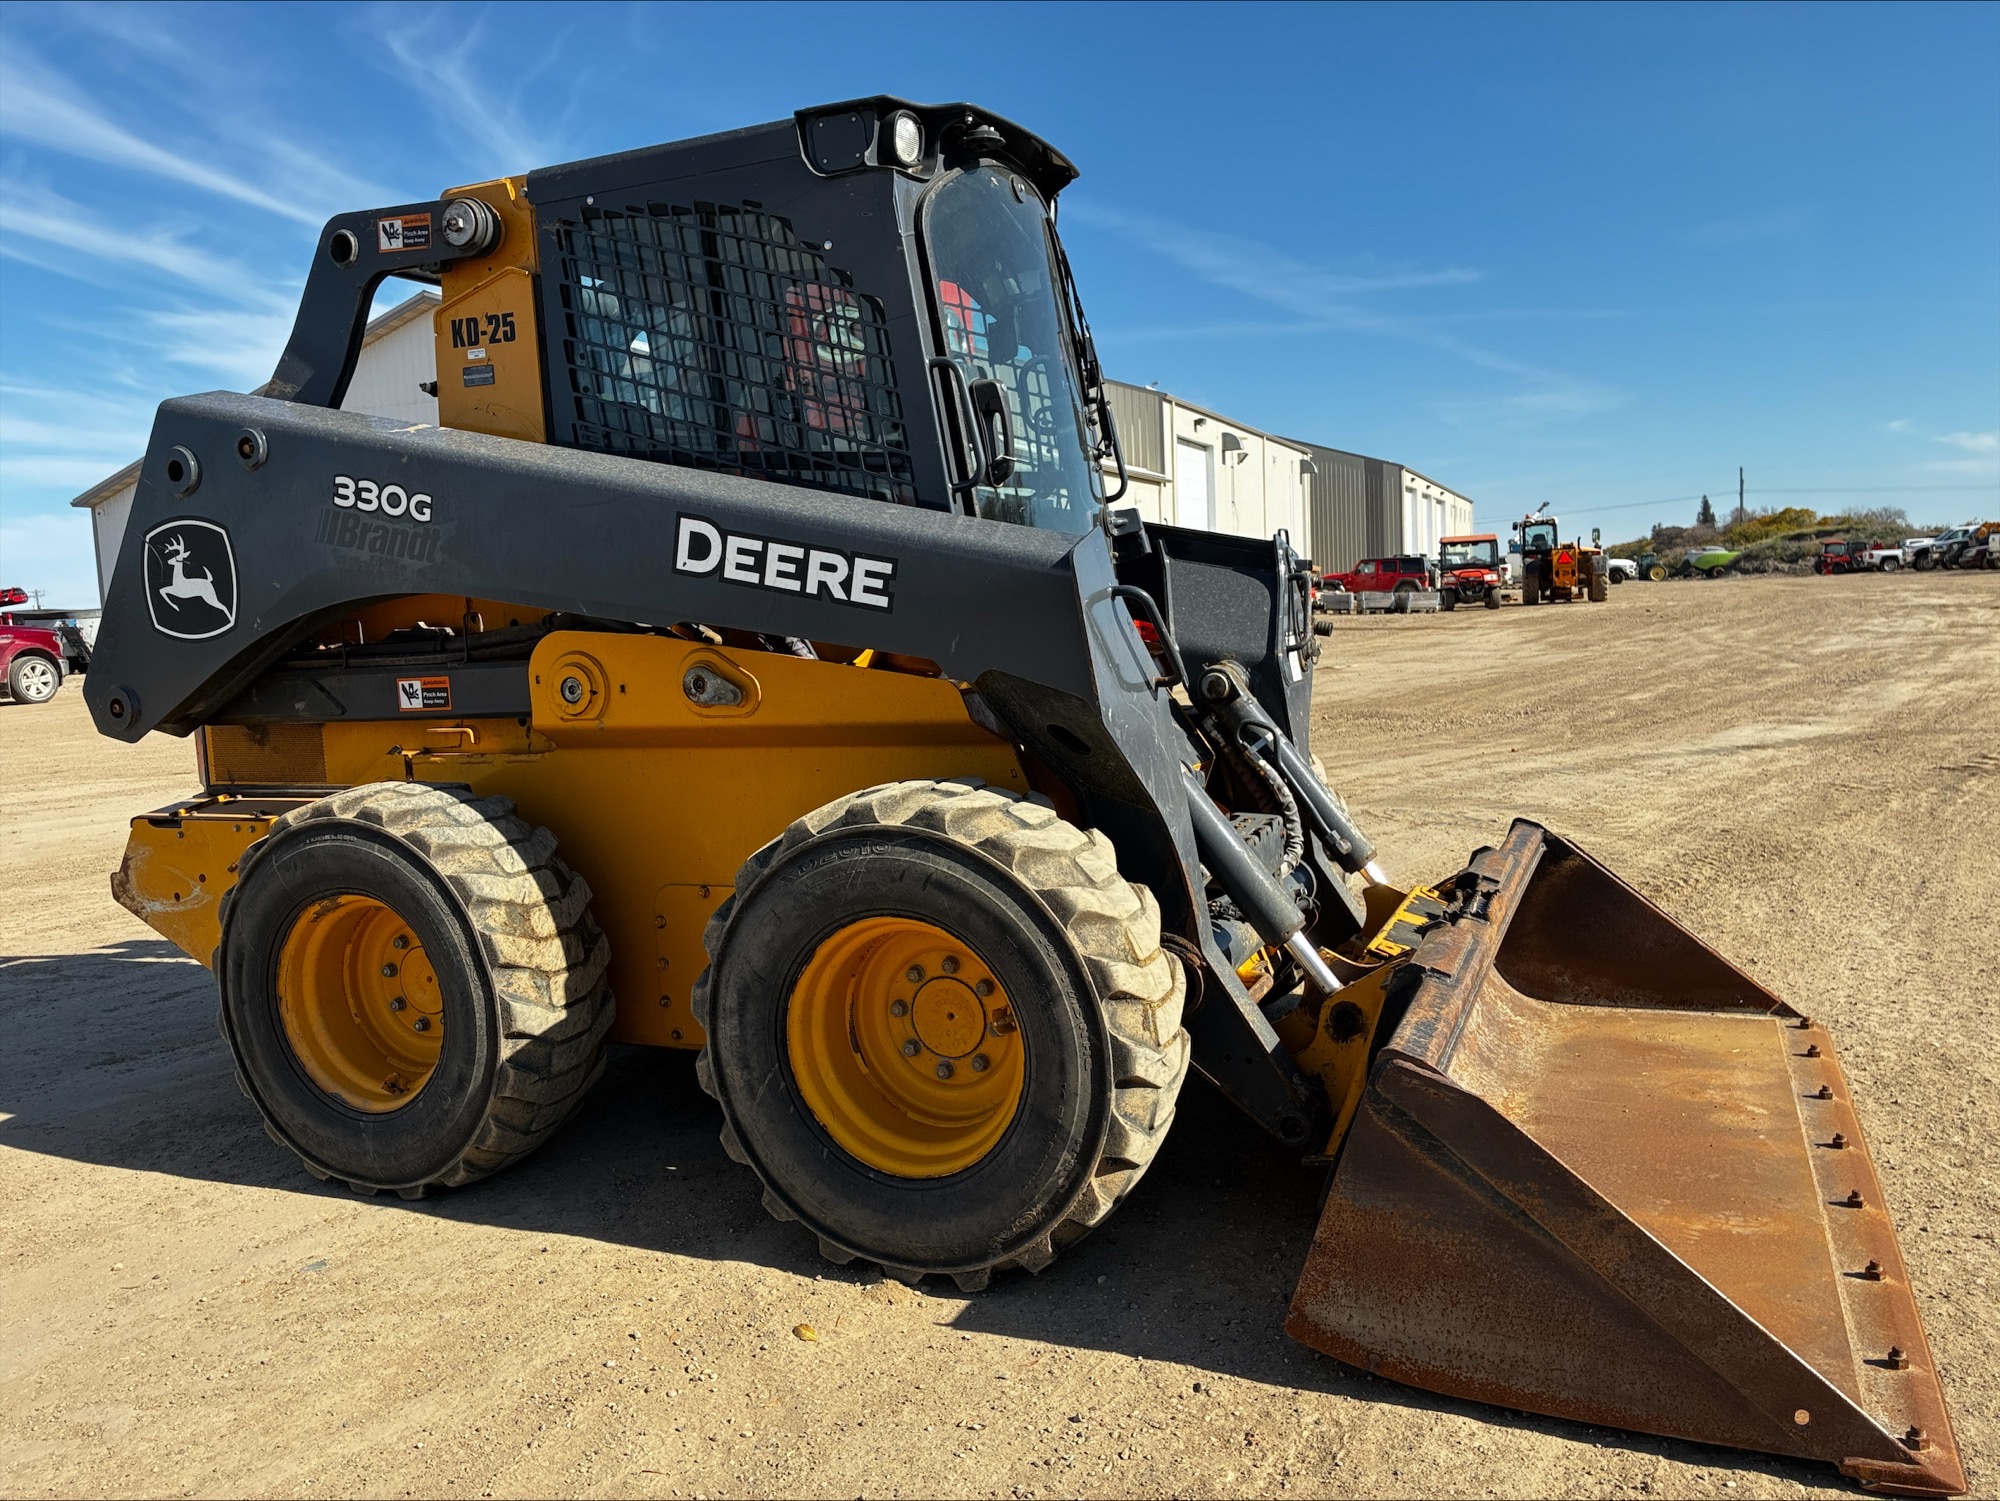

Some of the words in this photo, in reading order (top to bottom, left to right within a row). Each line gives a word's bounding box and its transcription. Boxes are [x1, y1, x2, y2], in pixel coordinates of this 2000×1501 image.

[451, 312, 516, 348] KD-25
[333, 476, 432, 522] 330G
[334, 510, 442, 563] Brandt
[675, 517, 893, 608] DEERE
